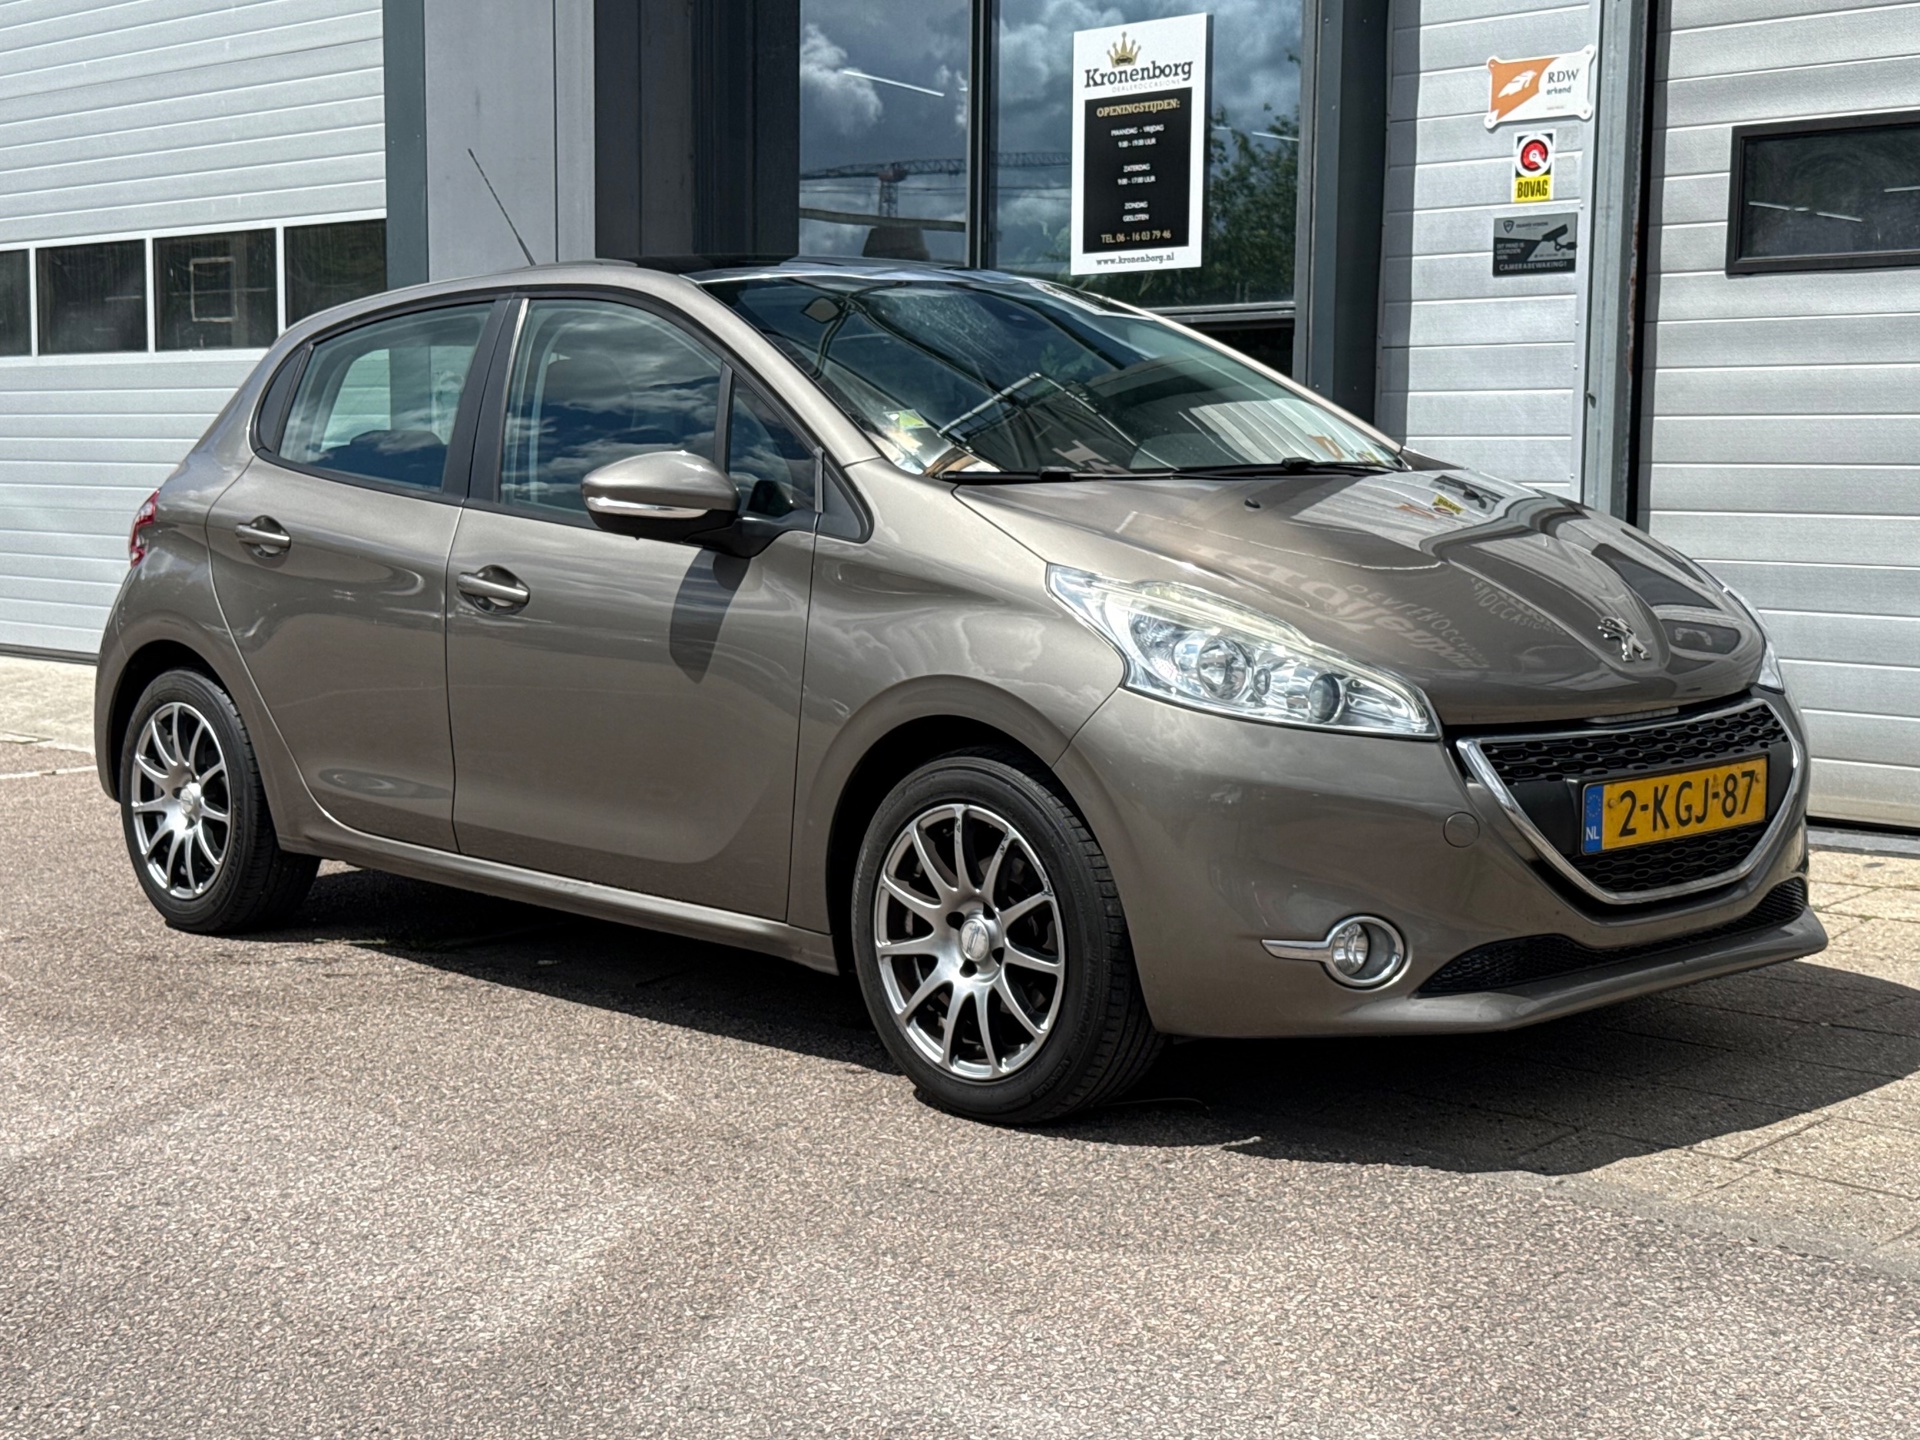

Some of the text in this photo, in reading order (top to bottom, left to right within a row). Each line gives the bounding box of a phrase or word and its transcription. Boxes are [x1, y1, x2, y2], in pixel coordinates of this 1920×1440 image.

[1084, 60, 1193, 88] Kronenborg
[1547, 68, 1580, 84] RDW
[1546, 85, 1572, 95] erkend
[1096, 98, 1180, 118] OPENINGSTIJDEN:
[1516, 179, 1549, 199] BOVAG
[1124, 201, 1148, 210] ZONDAG
[1122, 213, 1150, 222] GESLOTEN
[1116, 232, 1126, 243] 06
[1132, 231, 1140, 241] 16
[1141, 231, 1150, 241] 03
[1152, 230, 1161, 240] 79
[1162, 229, 1171, 239] 46
[1096, 252, 1175, 266] www.kronenborg.nl
[1619, 769, 1756, 838] 2-KGJ-87
[1585, 825, 1600, 841] NL
